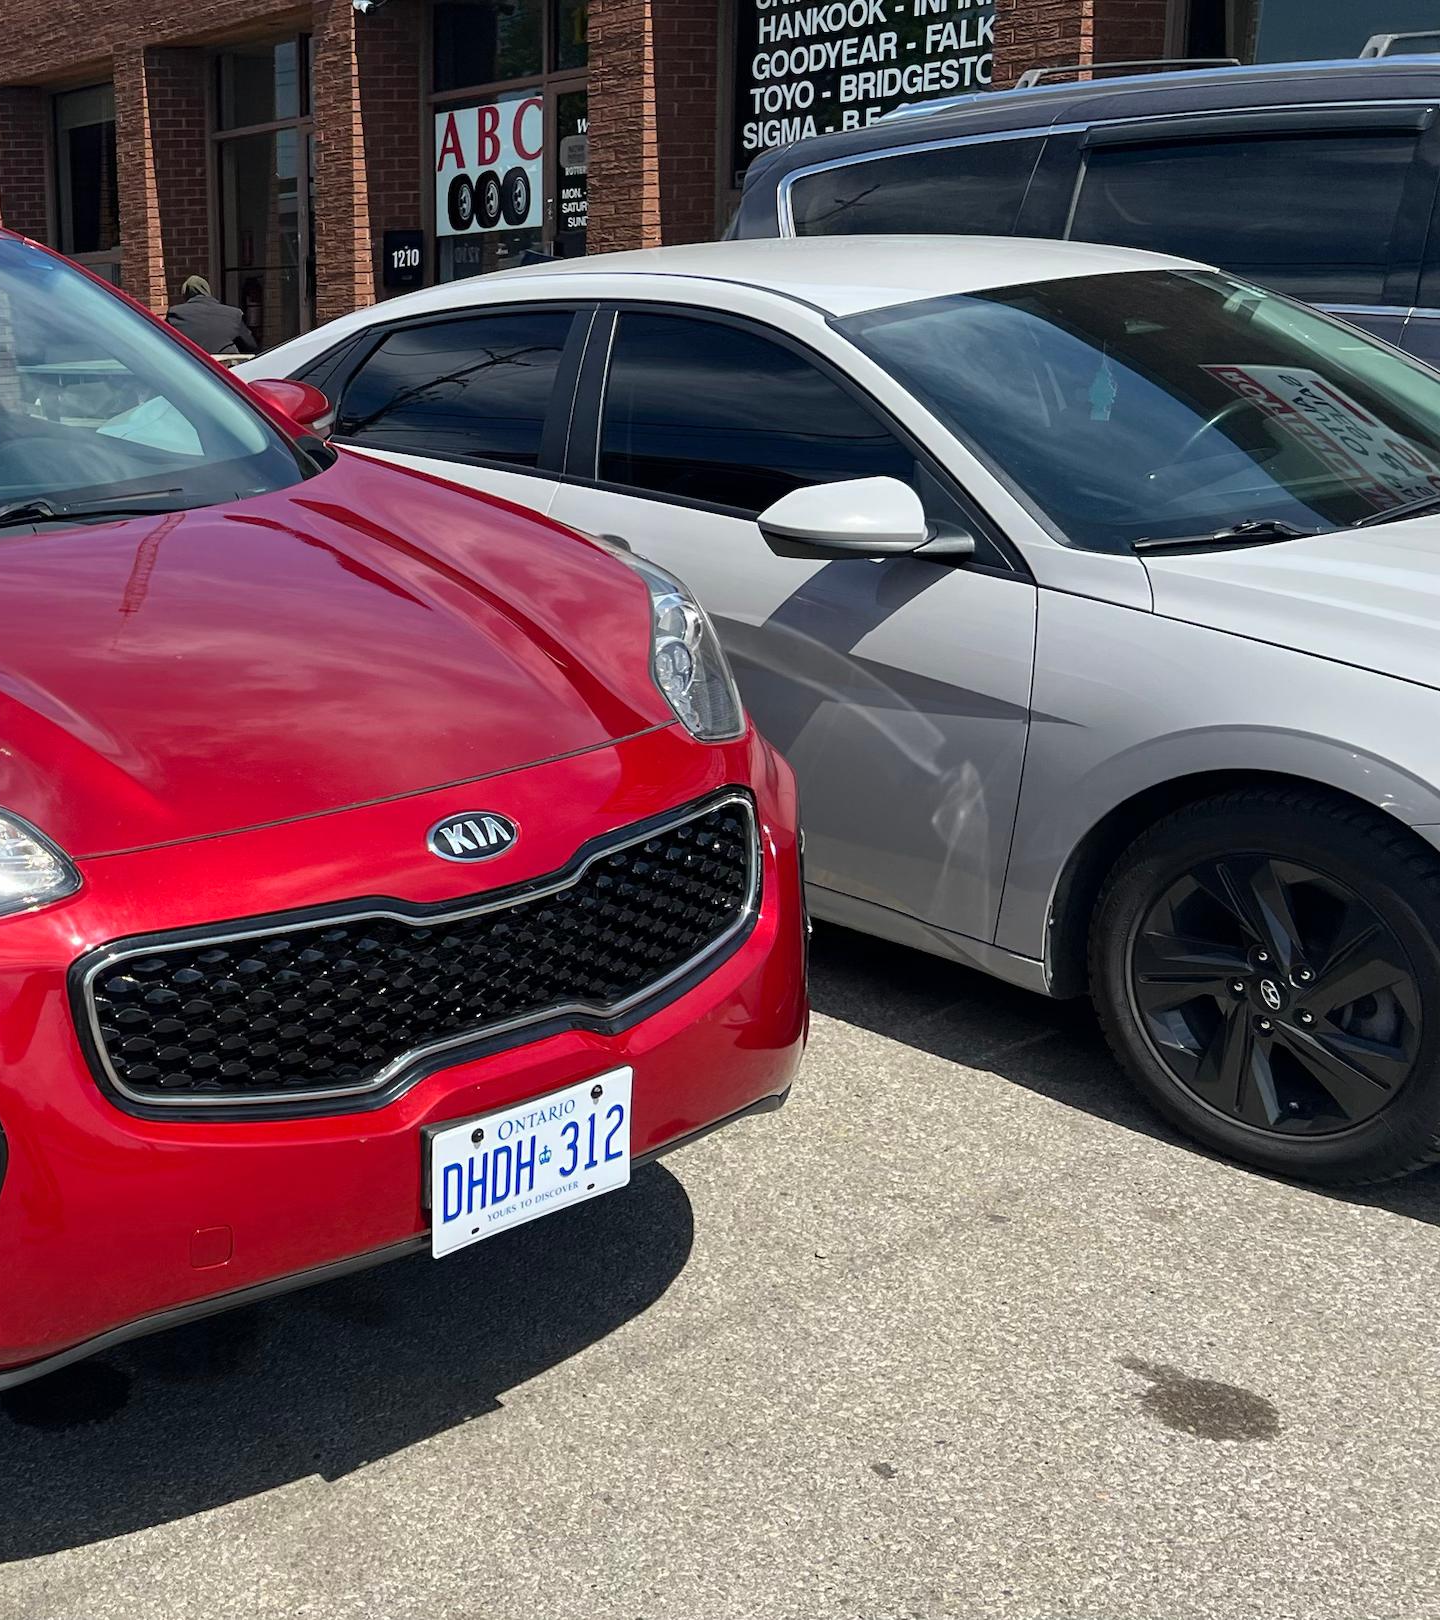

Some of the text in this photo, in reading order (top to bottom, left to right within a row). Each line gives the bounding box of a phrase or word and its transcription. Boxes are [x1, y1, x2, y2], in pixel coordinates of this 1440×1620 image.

[758, 0, 887, 44] HANKOOK
[752, 31, 897, 80] GOODYEAR
[750, 81, 814, 114] TOYO
[743, 115, 817, 149] SIGMA
[392, 249, 420, 268] 1210
[439, 816, 511, 855] KIA
[497, 1100, 576, 1141] ONTARIO
[487, 1180, 579, 1222] YOURS TO DISCOVER
